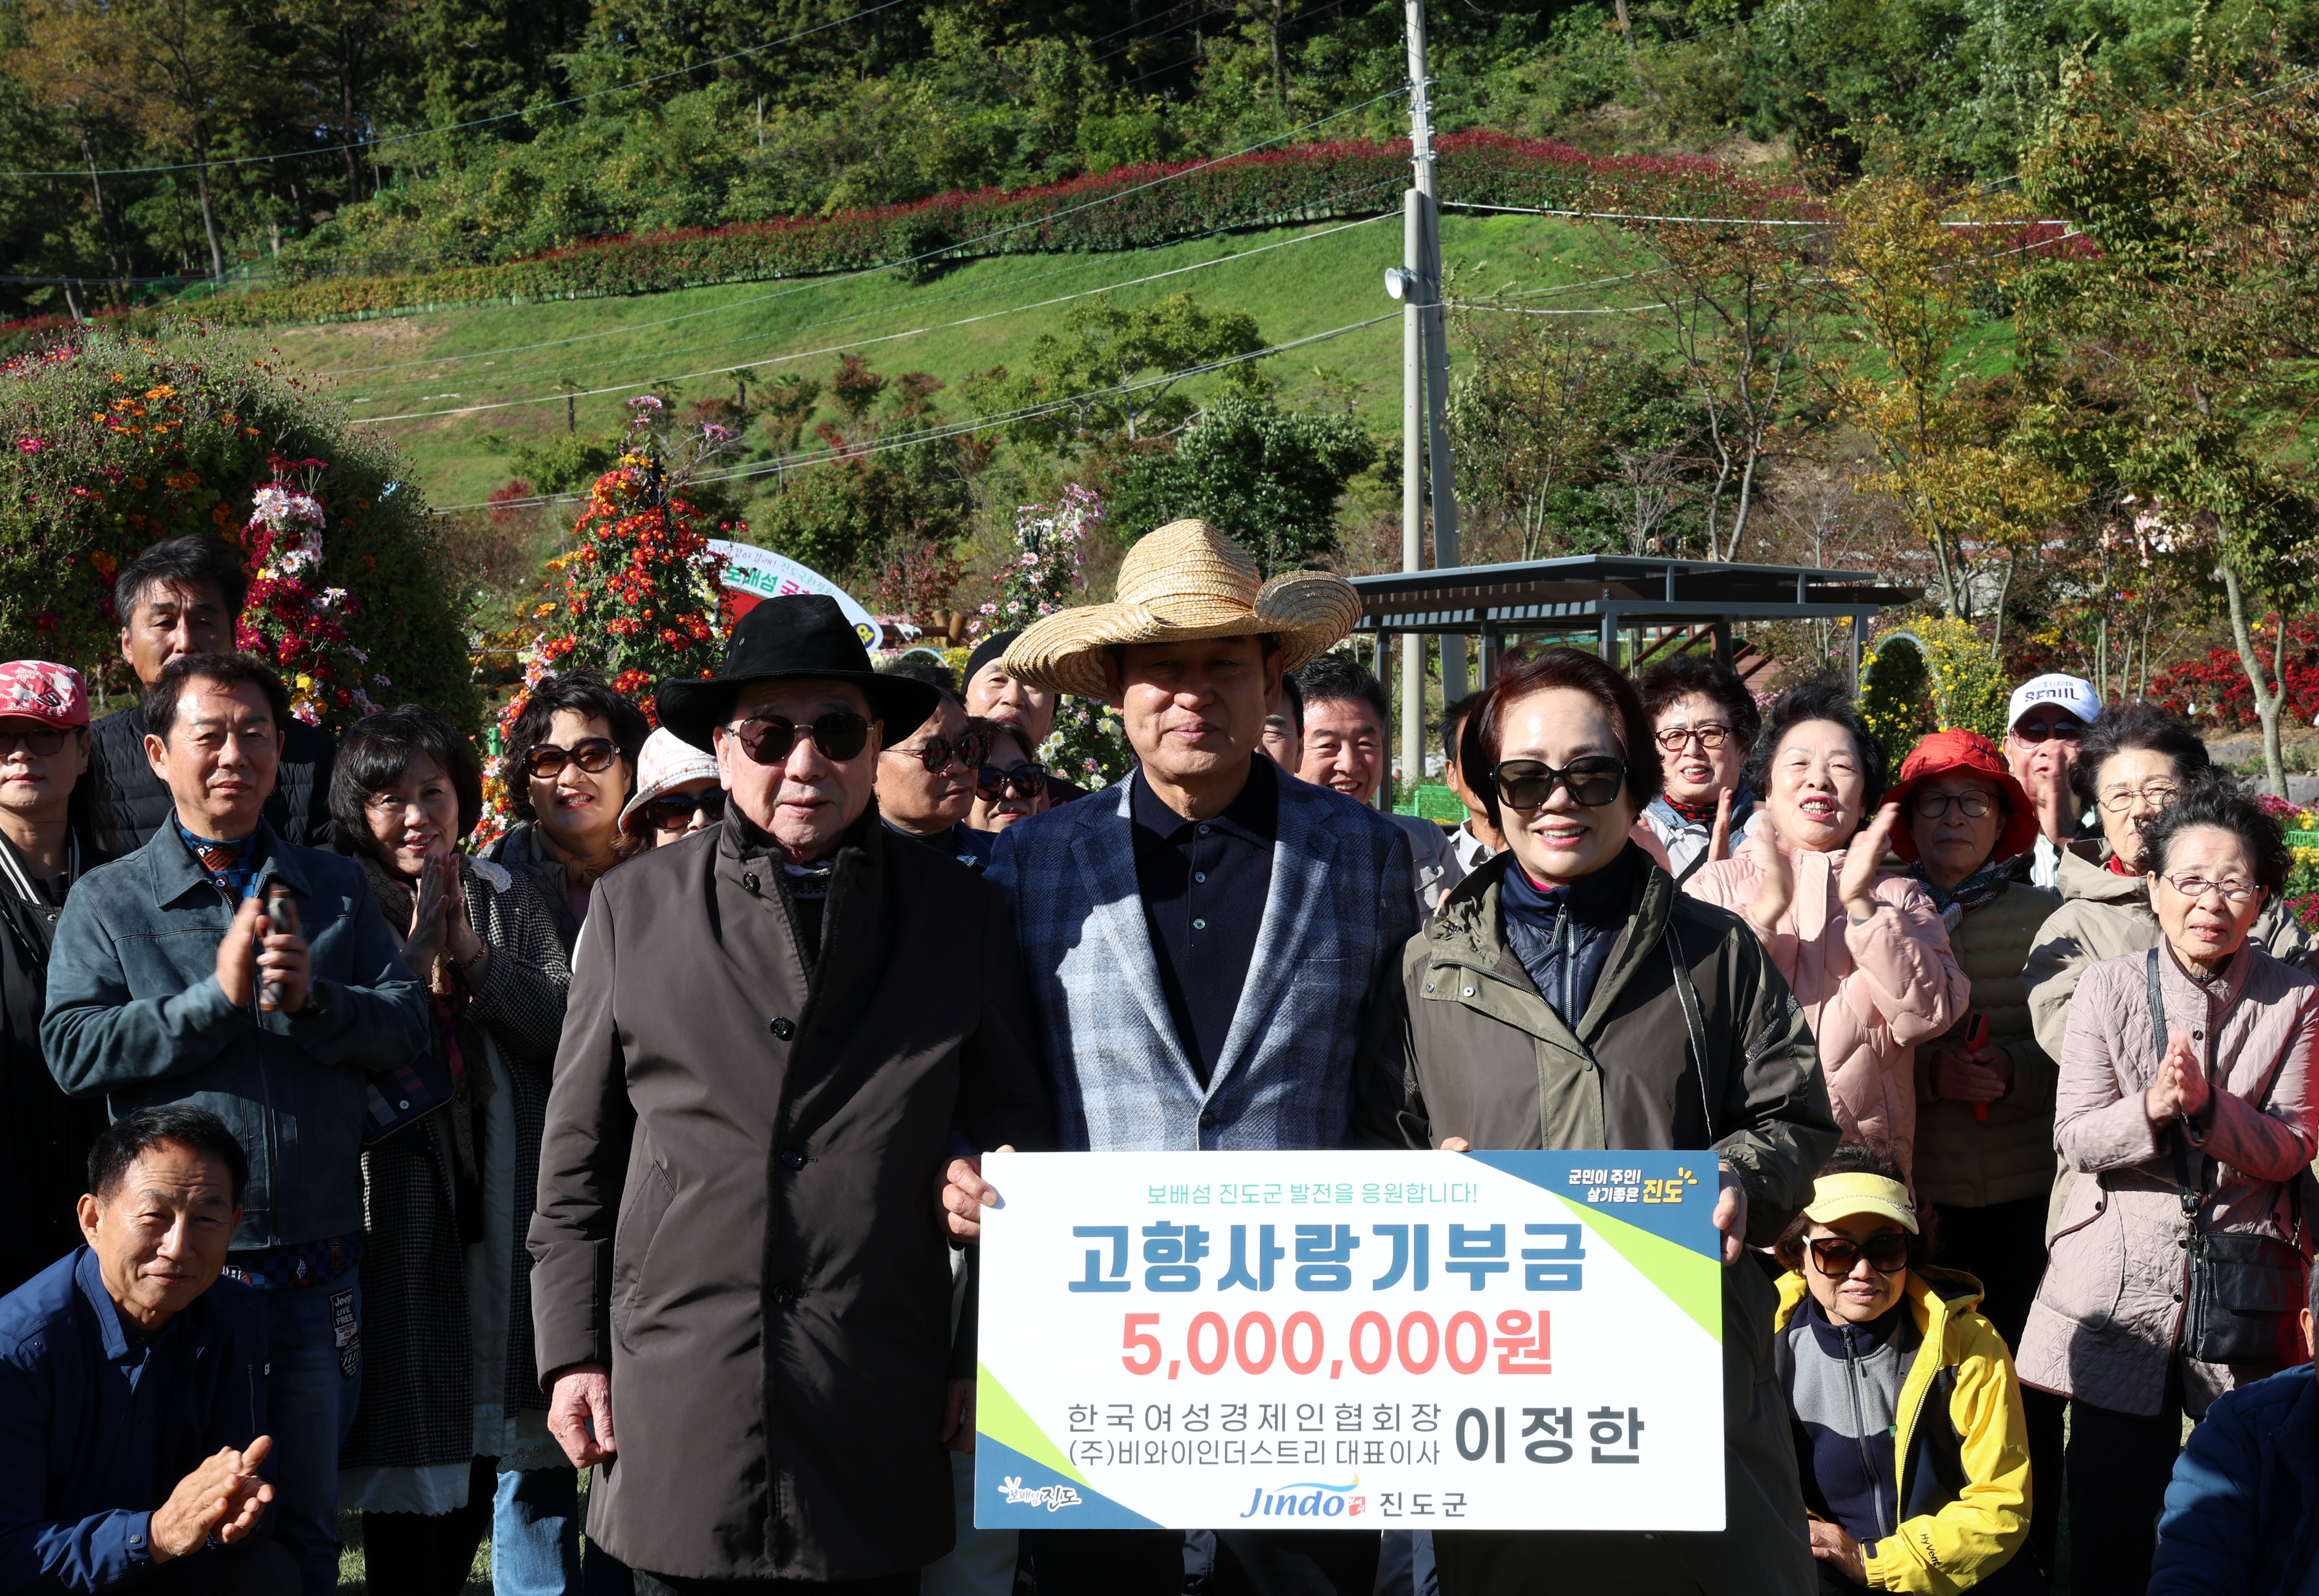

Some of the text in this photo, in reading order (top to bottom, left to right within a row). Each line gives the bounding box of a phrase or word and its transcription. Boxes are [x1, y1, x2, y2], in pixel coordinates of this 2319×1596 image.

[724, 564, 810, 596] 보배섬 국
[754, 552, 777, 567] 갈래!
[781, 562, 835, 596] 진도국화정원
[2025, 688, 2080, 702] SEOUL
[2026, 681, 2048, 691] SPORTS
[1568, 1169, 1642, 1185] 군민이 주인!
[1148, 1183, 1477, 1204] 보배섬 진도군 발전을 응원합니다!
[1587, 1179, 1683, 1204] 살기좋은 진도
[1068, 1220, 1586, 1292] 고향사랑기부금
[335, 1294, 352, 1307] Jeep
[337, 1305, 351, 1317] LIVE
[336, 1315, 354, 1326] FREE
[1121, 1309, 1552, 1380] 5,000,000원
[1068, 1402, 1441, 1432] 한국여성경제인협회장
[1455, 1405, 1645, 1465] 이정한
[1069, 1440, 1440, 1467] (주)비와이인더스트리 대표이사
[1008, 1487, 1080, 1510] 보배섬 진도
[1240, 1488, 1345, 1518] Jindo
[1379, 1491, 1467, 1517] 진도군
[1920, 1533, 1942, 1566] HyVent
